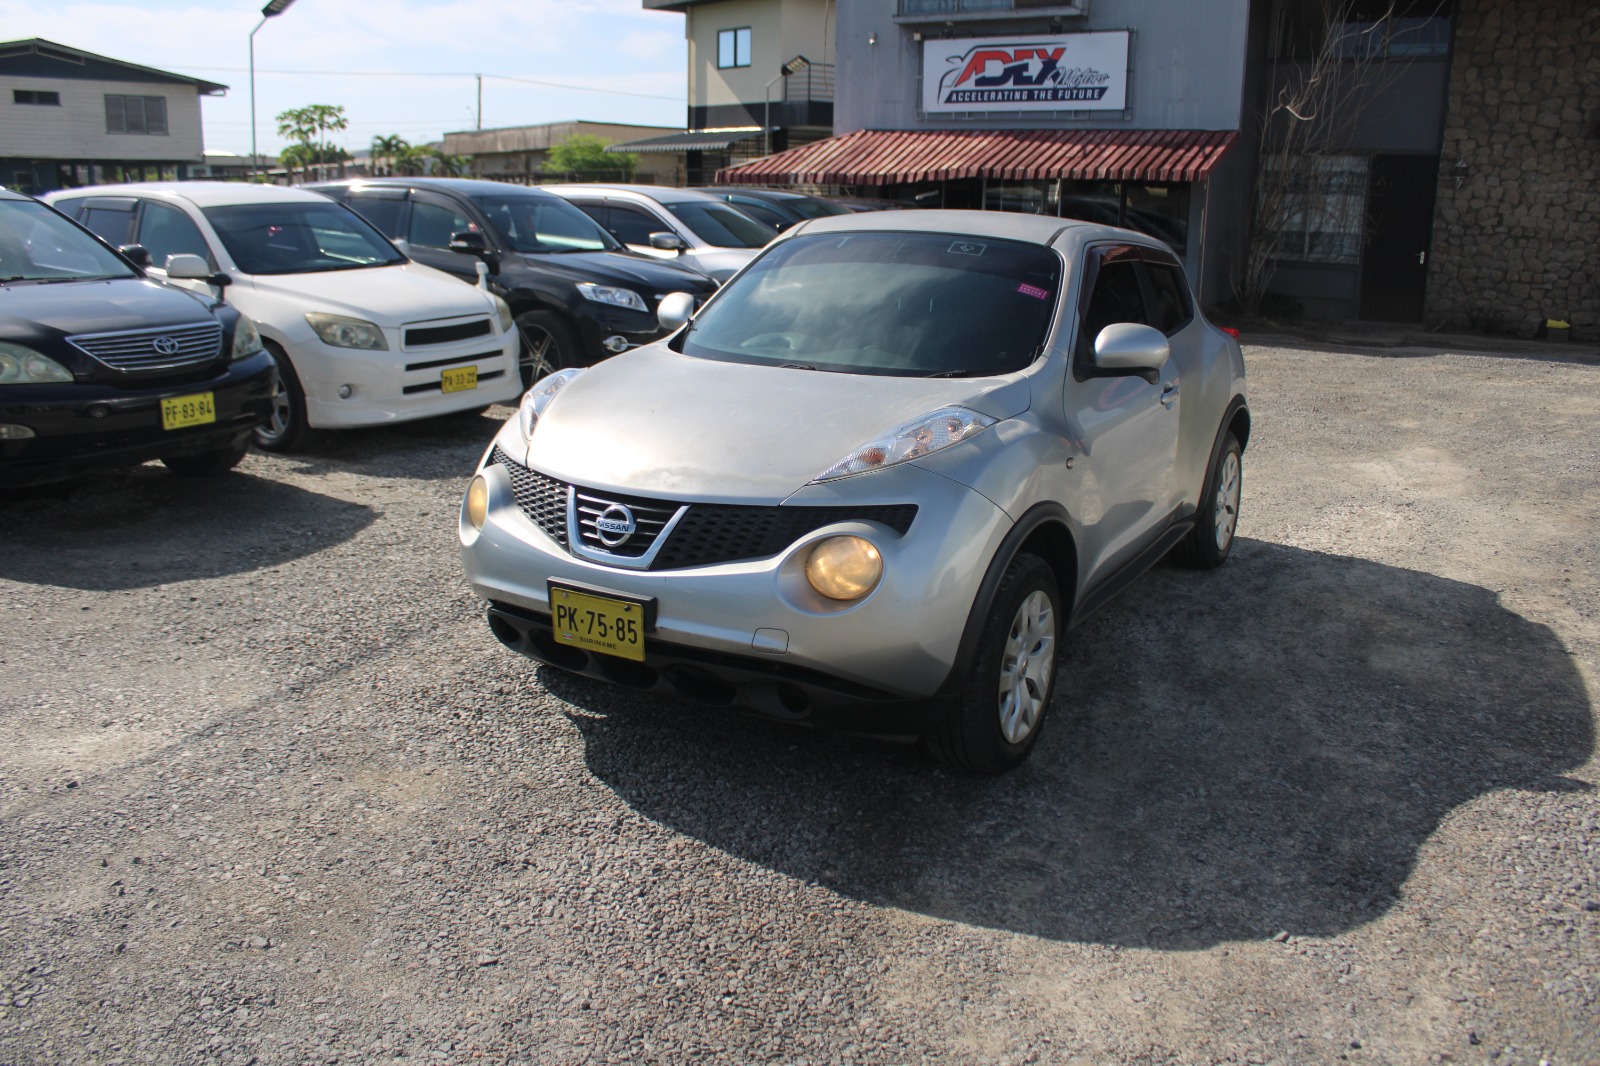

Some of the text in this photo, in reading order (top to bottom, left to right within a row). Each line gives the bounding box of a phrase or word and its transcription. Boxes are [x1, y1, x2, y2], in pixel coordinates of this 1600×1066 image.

[1048, 67, 1110, 88] Motors
[951, 89, 1100, 102] ACCELERATING THE FUTURE
[598, 520, 630, 532] NISSAN
[580, 636, 617, 650] SURINAME
